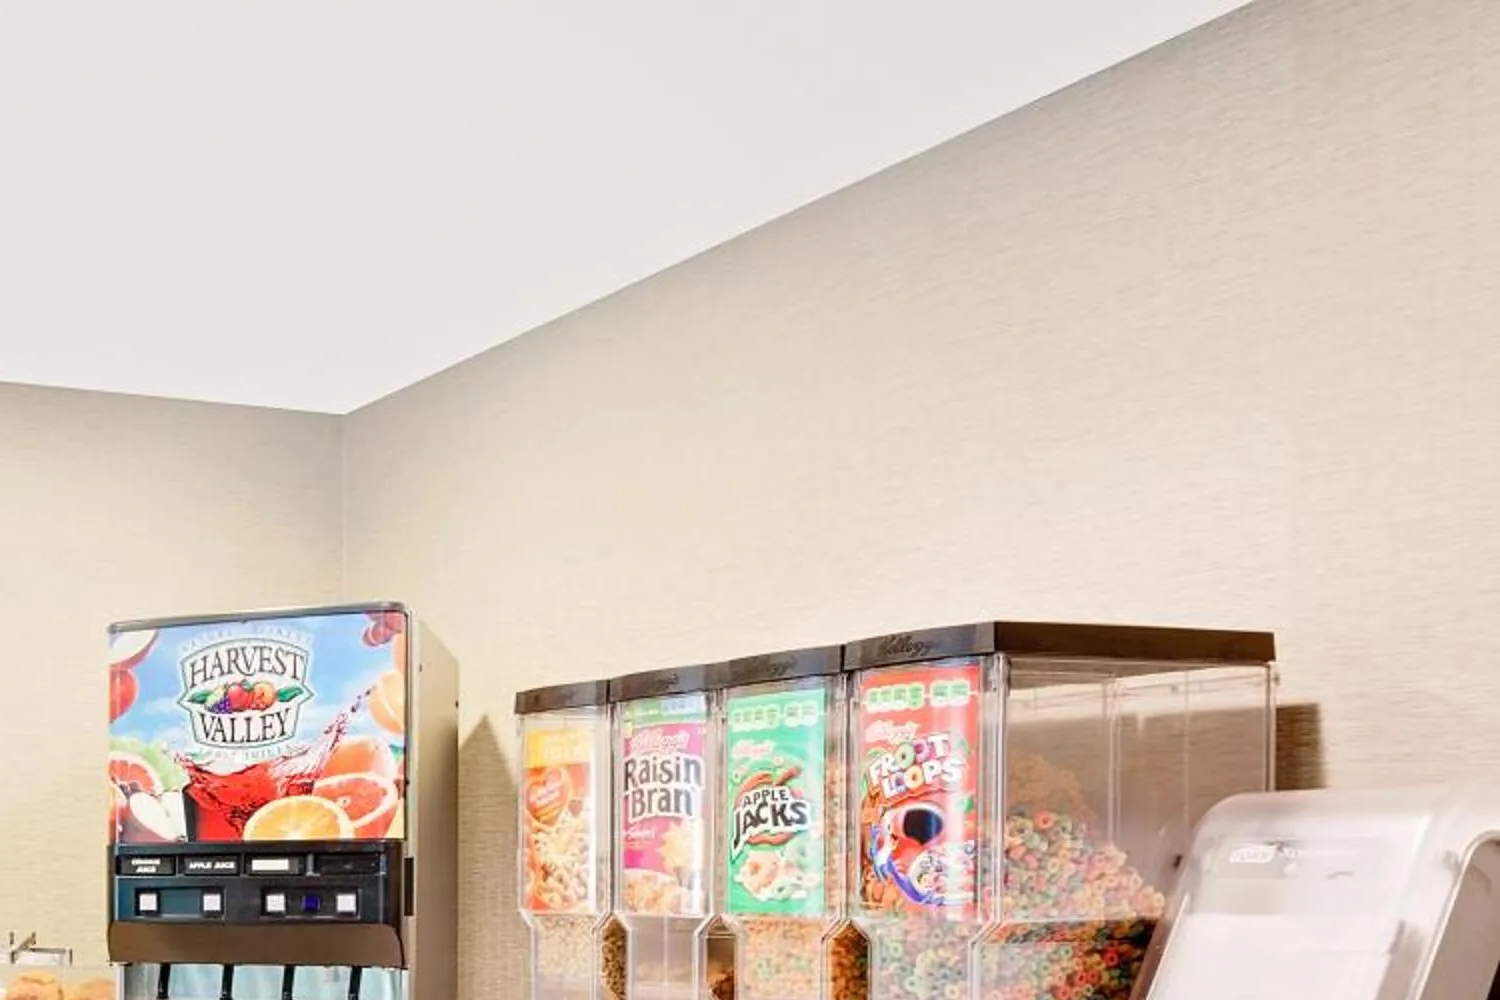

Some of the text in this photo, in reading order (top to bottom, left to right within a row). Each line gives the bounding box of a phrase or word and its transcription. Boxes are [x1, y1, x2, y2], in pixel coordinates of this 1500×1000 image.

[190, 645, 305, 688] HARVEST
[200, 708, 292, 743] VALLEY
[624, 757, 702, 790] Raisin
[883, 759, 964, 797] LOOPS
[631, 787, 693, 819] Bran
[743, 789, 789, 807] APPLE
[733, 802, 809, 850] JACKS
